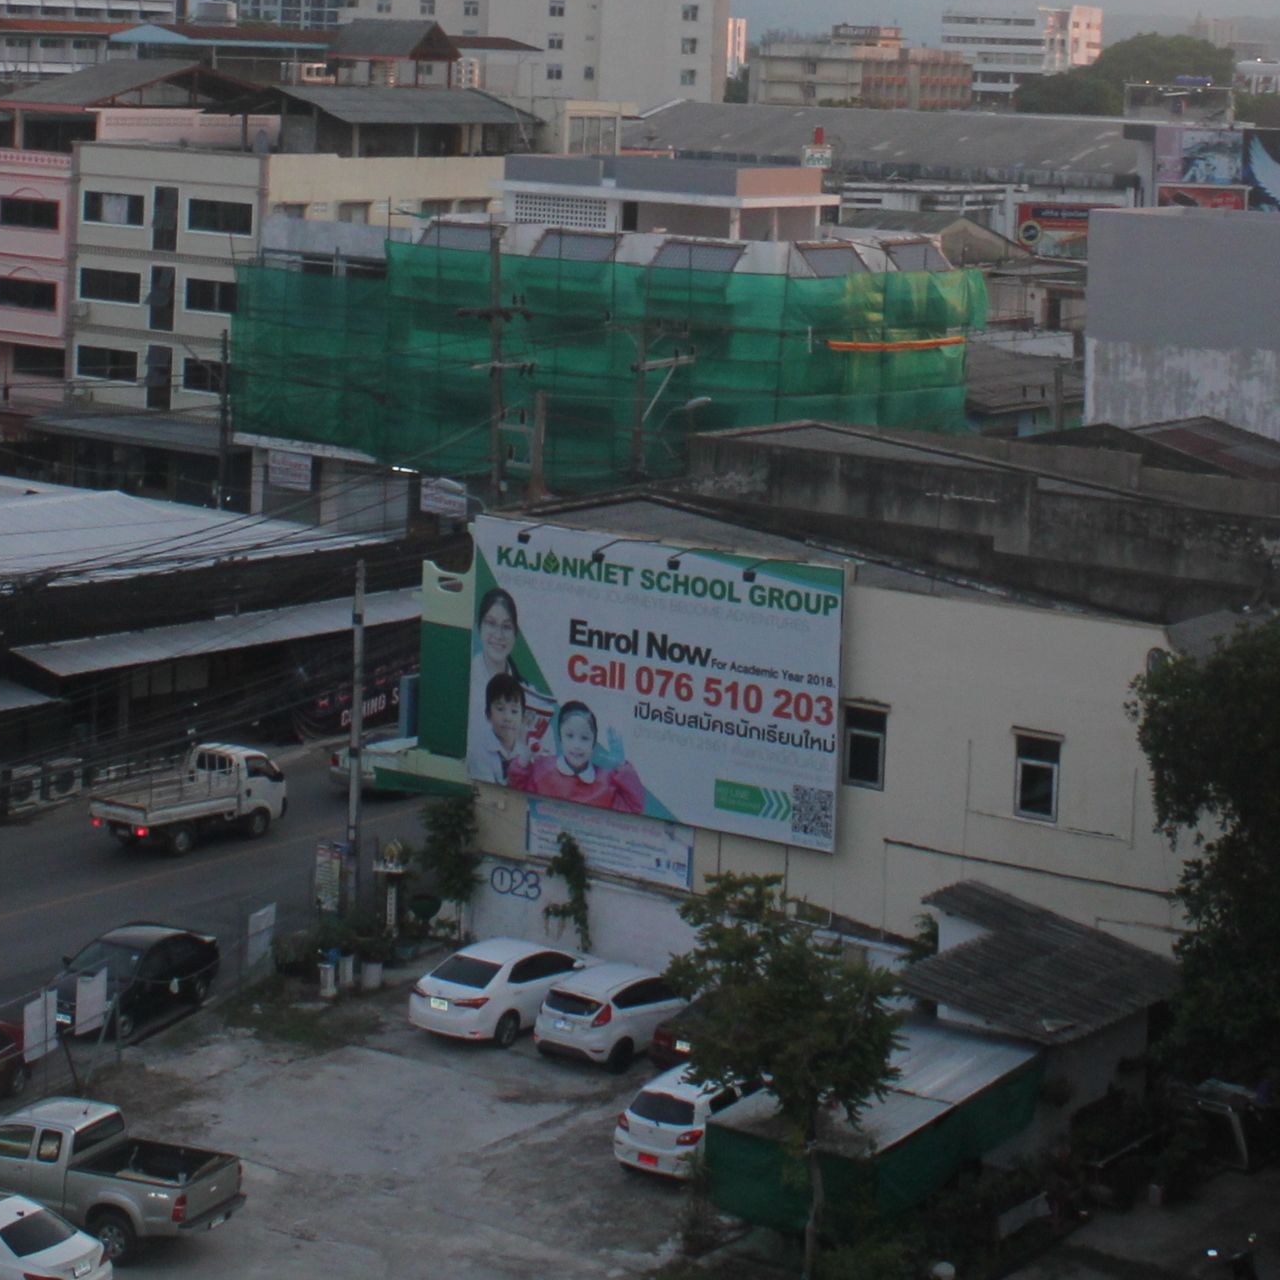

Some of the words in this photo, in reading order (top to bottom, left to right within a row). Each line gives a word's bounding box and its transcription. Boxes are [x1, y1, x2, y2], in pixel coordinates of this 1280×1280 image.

[496, 545, 634, 587] KAJONKIET
[640, 569, 742, 604] SCHOOL
[749, 585, 839, 617] GROUP
[569, 619, 639, 657] Enrol
[646, 632, 712, 667] Now
[567, 655, 626, 691] Call
[635, 666, 694, 702] 076
[703, 678, 763, 715] 510
[772, 688, 835, 726] 203
[711, 658, 728, 671] For
[730, 661, 779, 680] Academic
[782, 669, 805, 684] Year
[633, 703, 837, 754] เปิดรับสมัครนักเรียนใหม่
